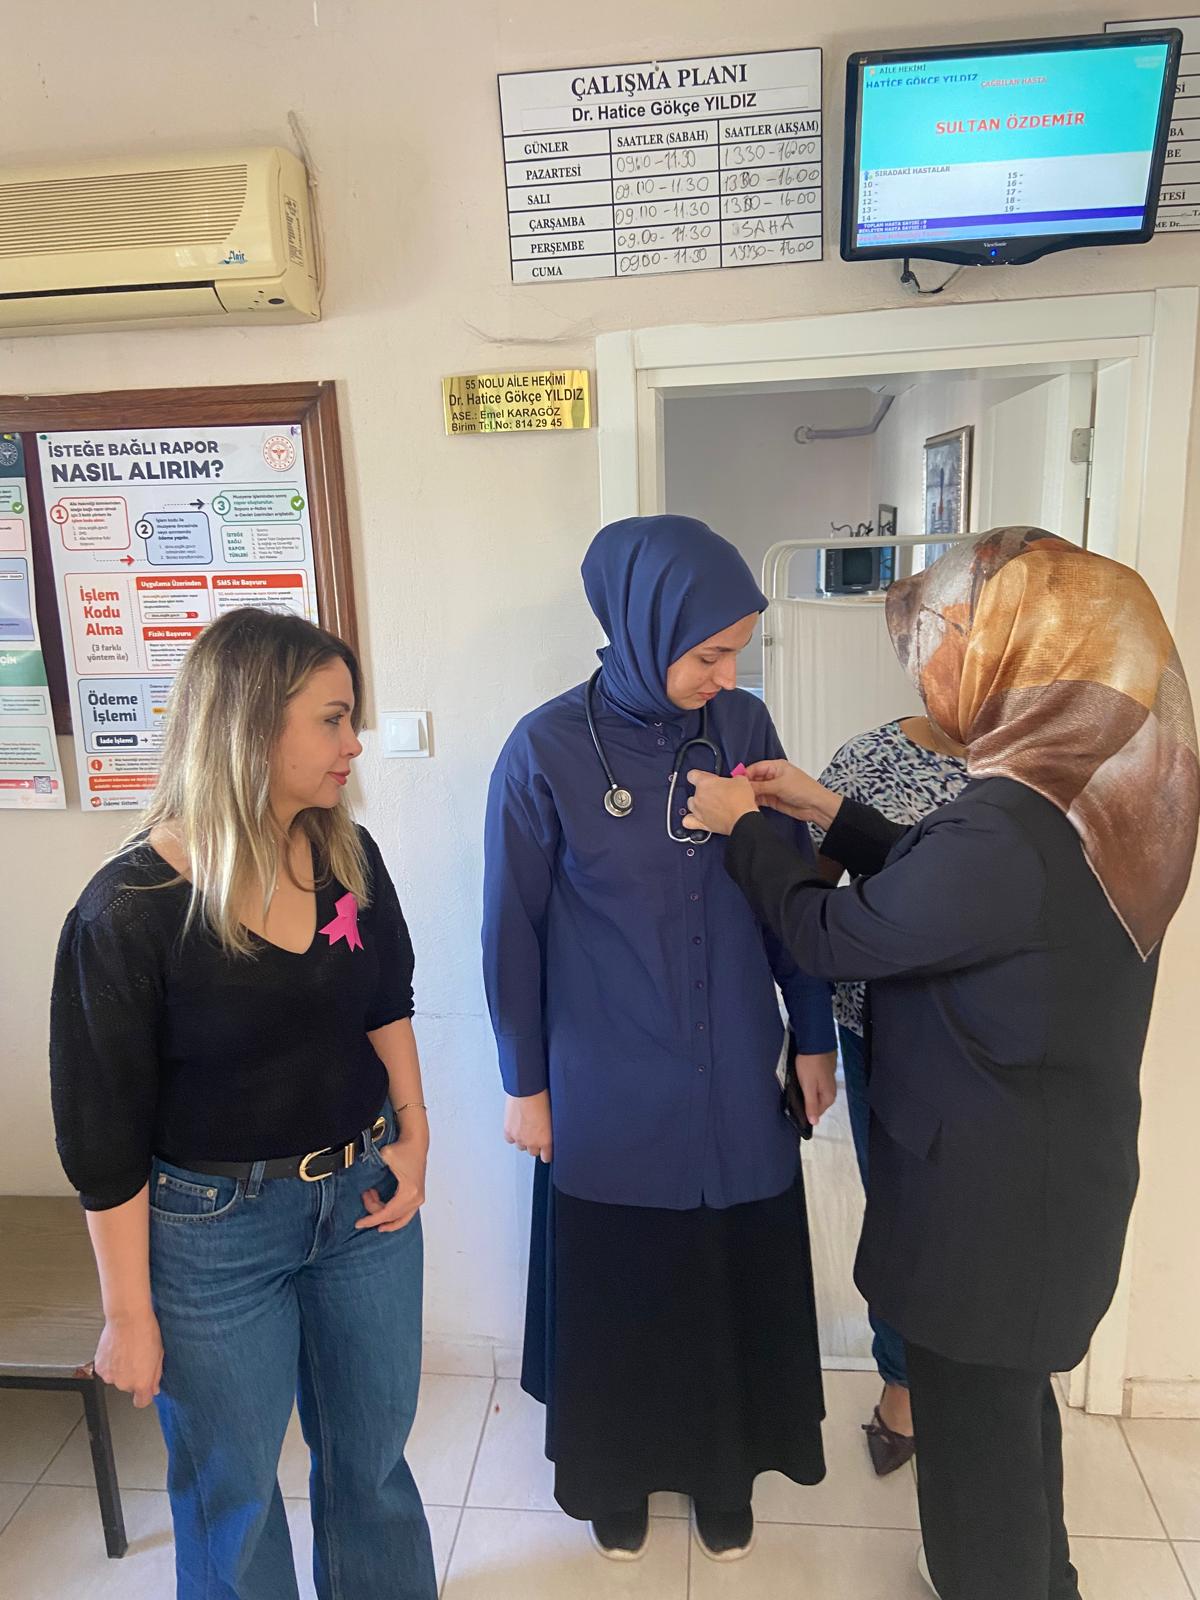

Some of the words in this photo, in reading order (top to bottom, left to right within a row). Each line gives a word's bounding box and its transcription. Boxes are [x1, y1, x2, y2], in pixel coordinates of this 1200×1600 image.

[571, 71, 672, 100] ÇALIŞMA
[678, 64, 748, 87] PLANI
[573, 107, 593, 121] Dr.
[598, 104, 646, 120] Hatice
[651, 100, 700, 117] Gökçe
[704, 93, 757, 112] YILDIZ
[725, 124, 773, 138] SAATLER
[775, 120, 819, 136] (AKŞAM)
[936, 118, 1000, 134] SULTAN
[1006, 111, 1085, 129] ÖZDEMİR
[617, 134, 664, 147] SAATLER
[666, 130, 709, 146] (SABAH)
[524, 141, 569, 155] GÜNLER
[526, 164, 581, 180] PAZARTESİ
[874, 167, 911, 177] SIRADAKİ
[912, 165, 951, 175] HASTALAR
[527, 194, 551, 206] SALI
[529, 216, 586, 232] ÇARŞAMBA
[741, 215, 794, 238] SAHA
[531, 240, 585, 255] PERŞEMBE
[532, 266, 563, 278] CUMA
[465, 380, 476, 389] 55
[478, 377, 504, 388] NOLU
[507, 374, 529, 387] AİLE
[532, 373, 566, 386] HEKİMİ
[449, 394, 464, 406] Dr.
[467, 392, 501, 405] Hatice
[505, 390, 541, 405] Gökçe
[545, 388, 584, 401] YILDIZ
[480, 409, 504, 419] Emel
[507, 407, 560, 417] KARAGÖZ
[452, 422, 476, 431] Birim
[515, 419, 533, 428] 814
[535, 418, 547, 427] 29
[550, 418, 562, 427] 45
[48, 440, 105, 458] İSTEĞE
[108, 439, 156, 456] BAĞLI
[160, 440, 219, 454] RAPOR
[51, 462, 123, 483] NASIL
[129, 459, 224, 481] ALIRIM?
[217, 500, 226, 511] 3
[55, 509, 64, 520] 1
[140, 524, 149, 534] 2
[141, 580, 171, 589] Uygulama
[172, 579, 202, 587] Üzerinden
[241, 579, 267, 587] Başvuru
[80, 585, 119, 604] İşlem
[84, 605, 121, 618] Kodu
[86, 623, 123, 635] Alma
[165, 630, 192, 638] Başvuru
[92, 644, 100, 652] (3
[87, 654, 116, 663] yöntem
[116, 653, 129, 662] ile)
[88, 690, 138, 706] Ödeme
[93, 706, 137, 725] İşlemi
